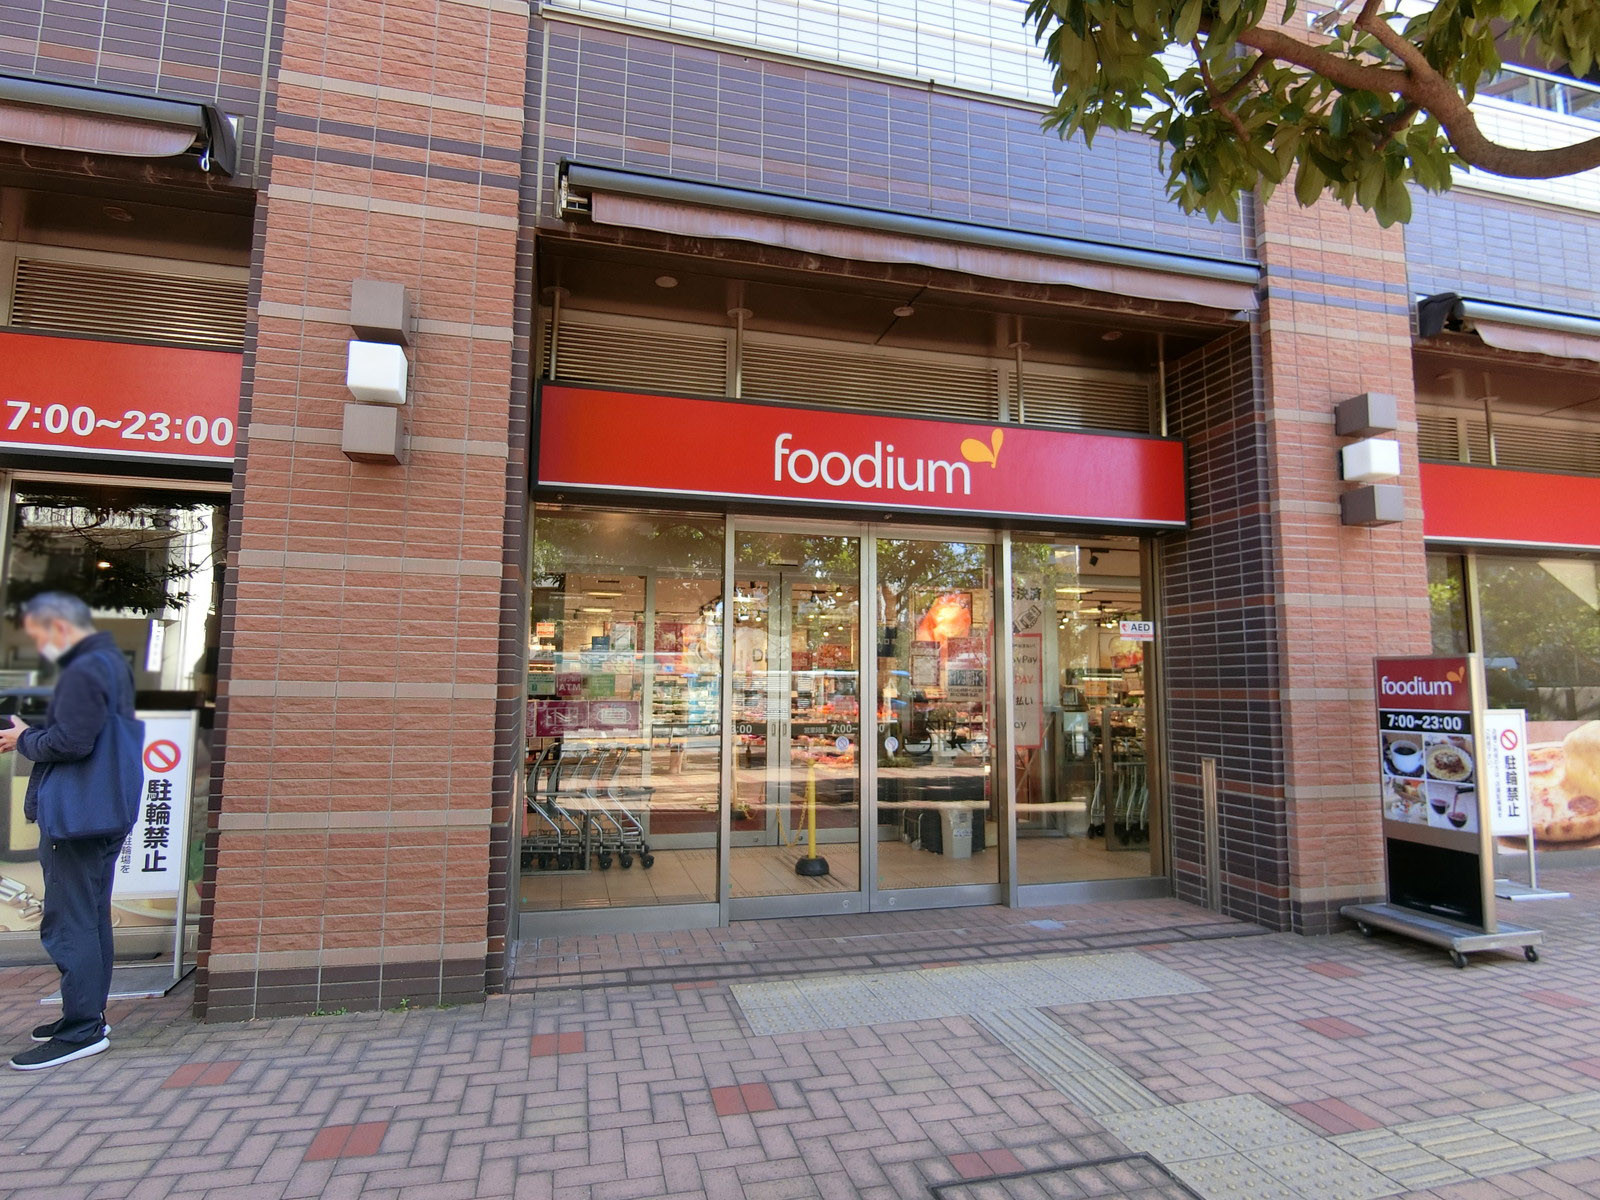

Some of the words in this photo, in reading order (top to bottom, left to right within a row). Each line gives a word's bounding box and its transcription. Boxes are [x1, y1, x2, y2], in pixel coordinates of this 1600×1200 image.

[6, 400, 234, 446] 7:00~23:00
[774, 432, 971, 495] foodium
[1131, 623, 1151, 632] AED
[559, 682, 580, 692] ATM
[1381, 675, 1453, 696] foodium
[1386, 713, 1462, 731] 7:00~23:00
[141, 779, 172, 872] 駐輪禁止
